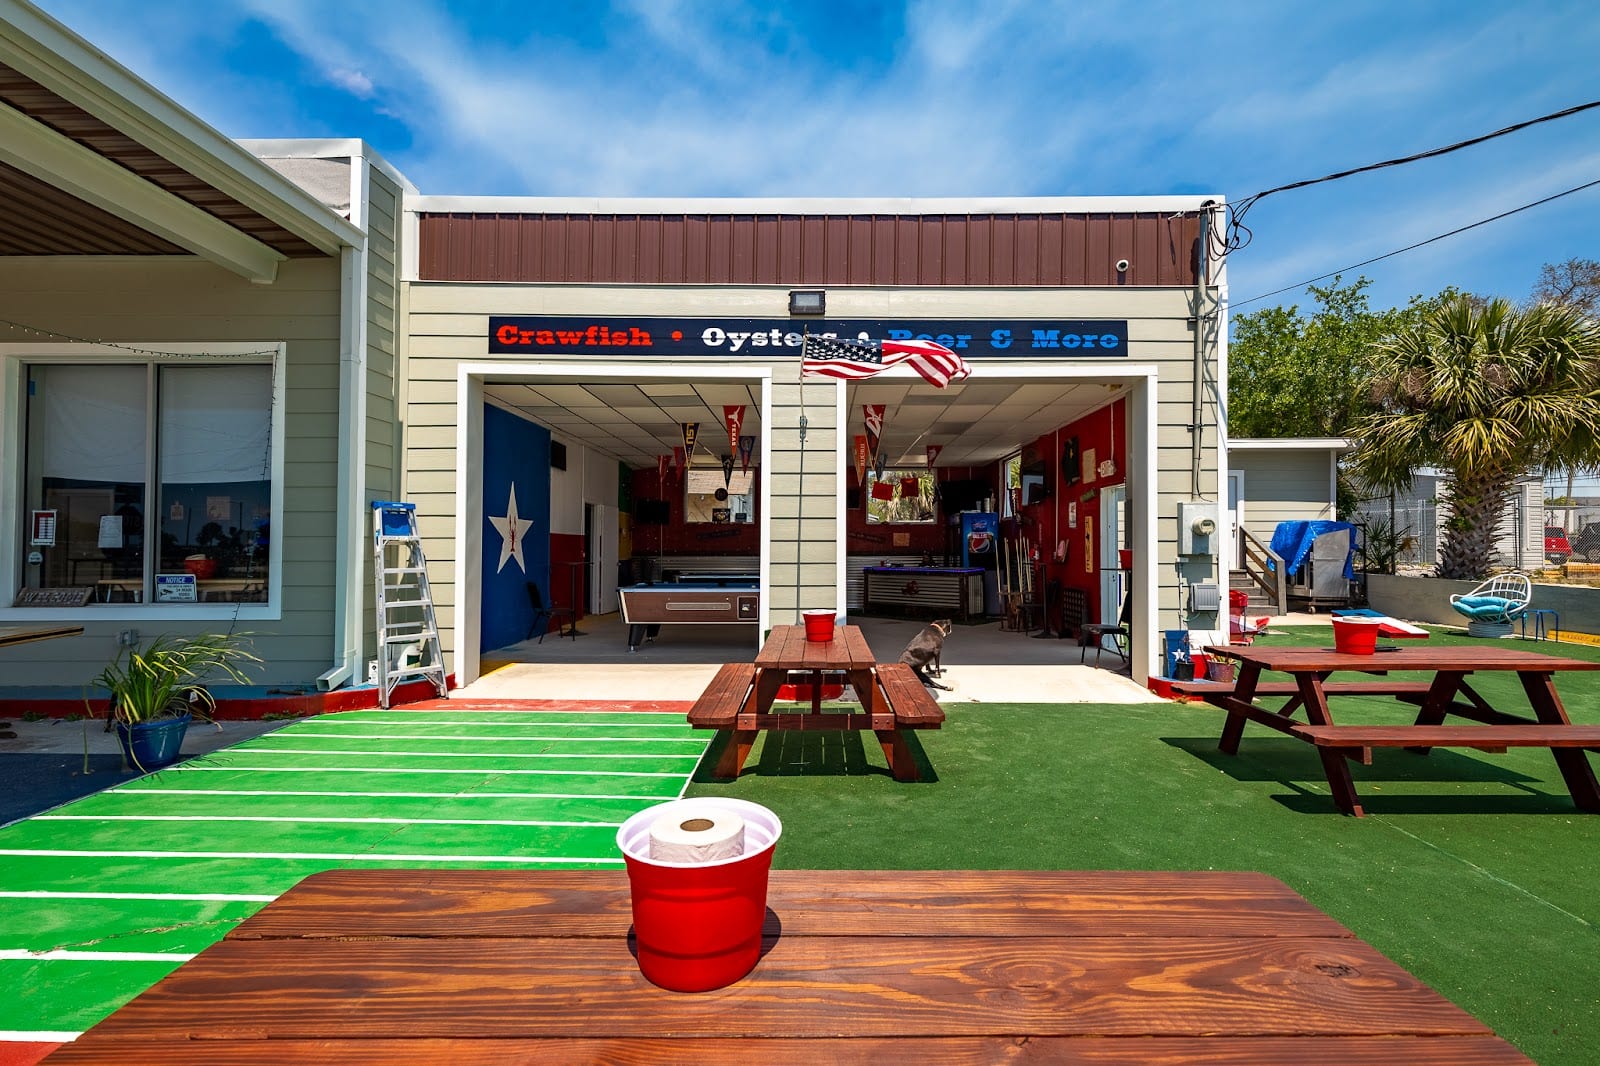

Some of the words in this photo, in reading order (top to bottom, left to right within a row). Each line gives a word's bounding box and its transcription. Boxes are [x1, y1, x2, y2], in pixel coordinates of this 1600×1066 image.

[496, 325, 653, 346] Crawfish
[701, 327, 837, 352] Oyste
[990, 330, 1014, 348] &
[1031, 330, 1119, 348] More
[686, 423, 694, 444] LSU
